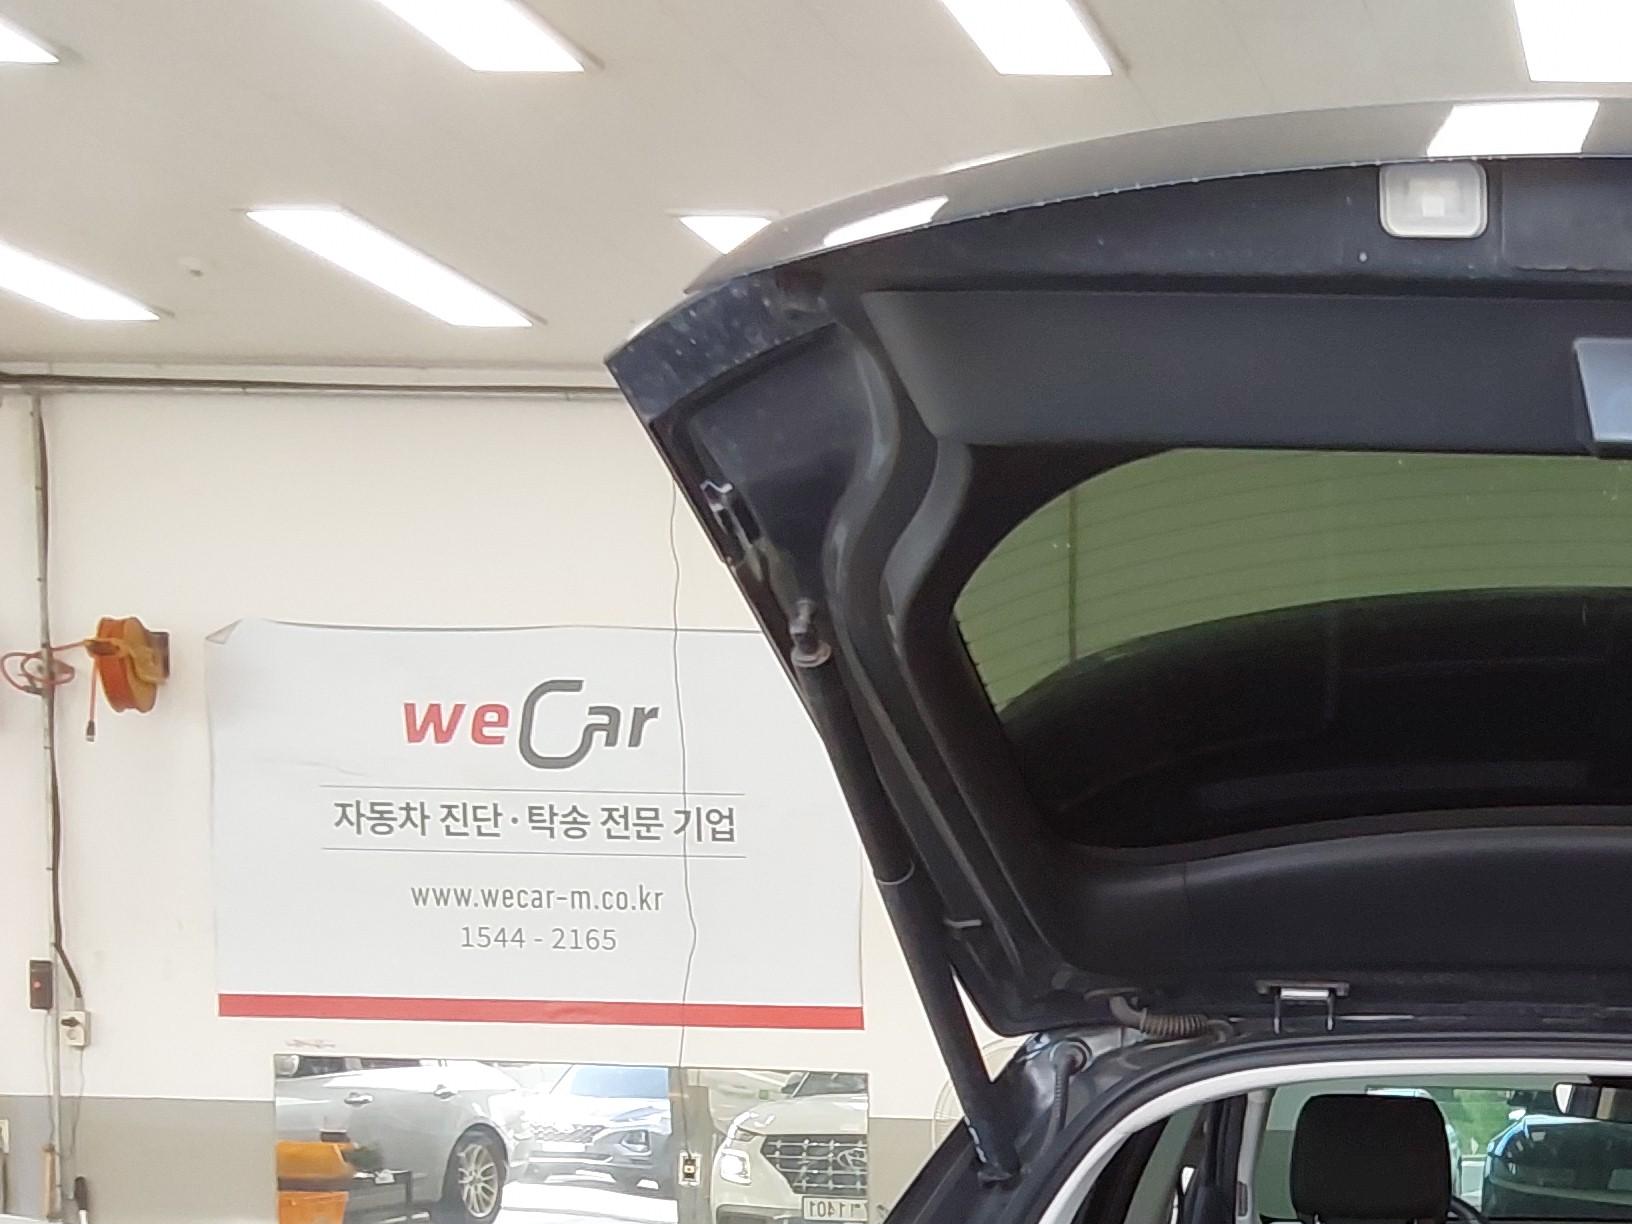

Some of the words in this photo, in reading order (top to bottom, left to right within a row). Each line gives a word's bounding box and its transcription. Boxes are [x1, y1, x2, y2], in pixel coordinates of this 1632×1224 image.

[334, 799, 431, 837] 자동차
[600, 805, 664, 841] 전문
[673, 806, 736, 843] 기업
[410, 884, 664, 911] www.wecar-m.co.kr
